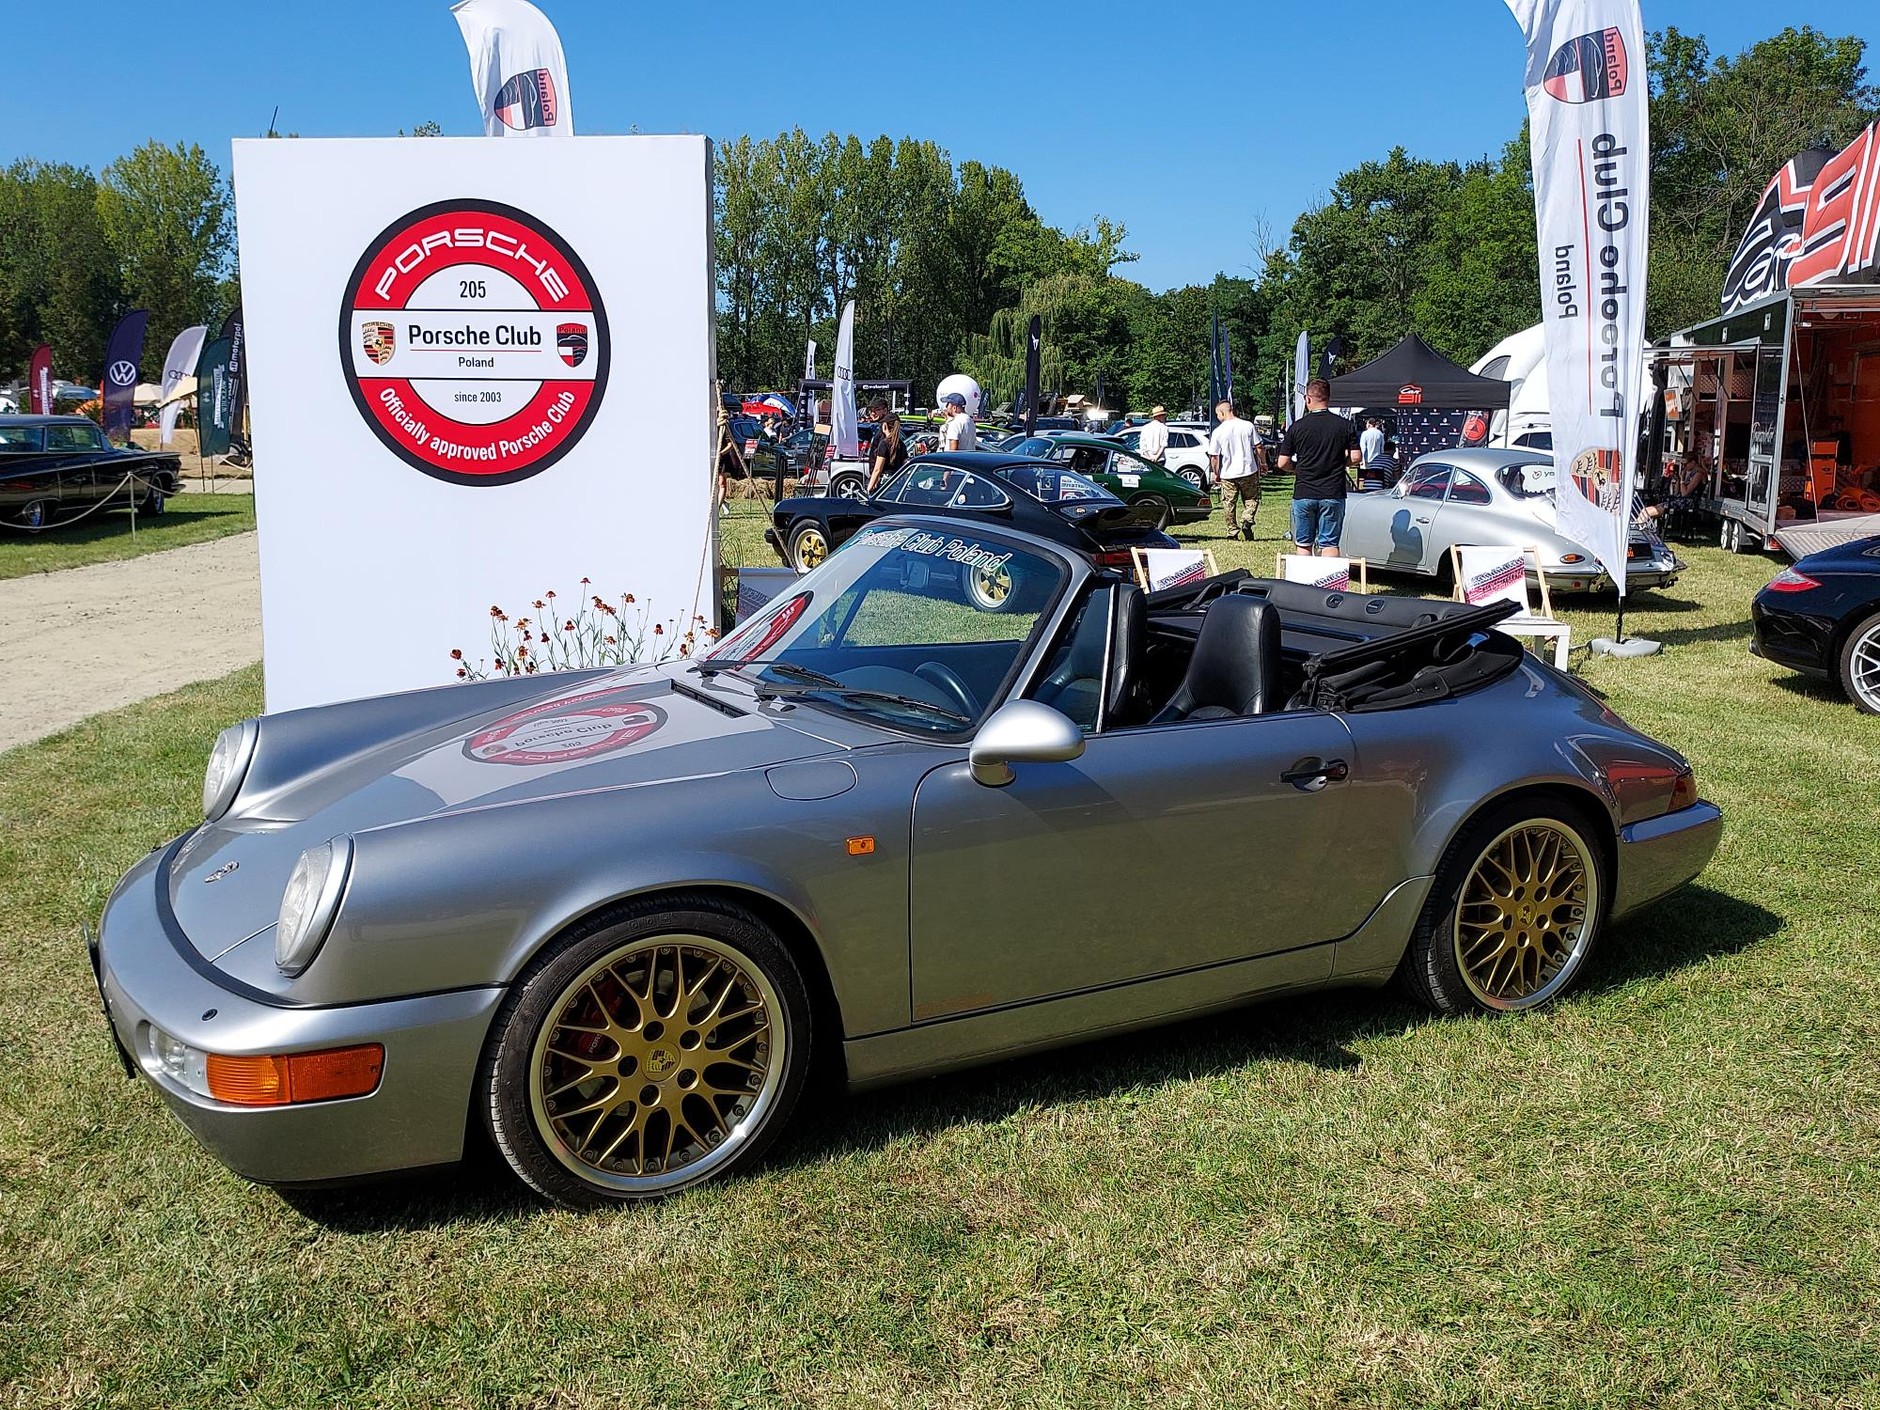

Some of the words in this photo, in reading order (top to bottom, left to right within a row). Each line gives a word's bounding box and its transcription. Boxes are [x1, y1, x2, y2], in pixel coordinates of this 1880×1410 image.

[375, 228, 570, 303] PORSCHE
[459, 280, 486, 299] 205
[409, 325, 490, 345] Porsche
[495, 325, 542, 346] Club
[458, 356, 494, 368] Poland
[454, 391, 477, 402] since
[480, 391, 501, 403] 2003
[380, 387, 431, 445] Officially
[430, 436, 497, 460] approved
[500, 420, 553, 458] Porsche
[547, 390, 576, 424] Club
[900, 532, 945, 555] Club
[935, 539, 1013, 572] Poland
